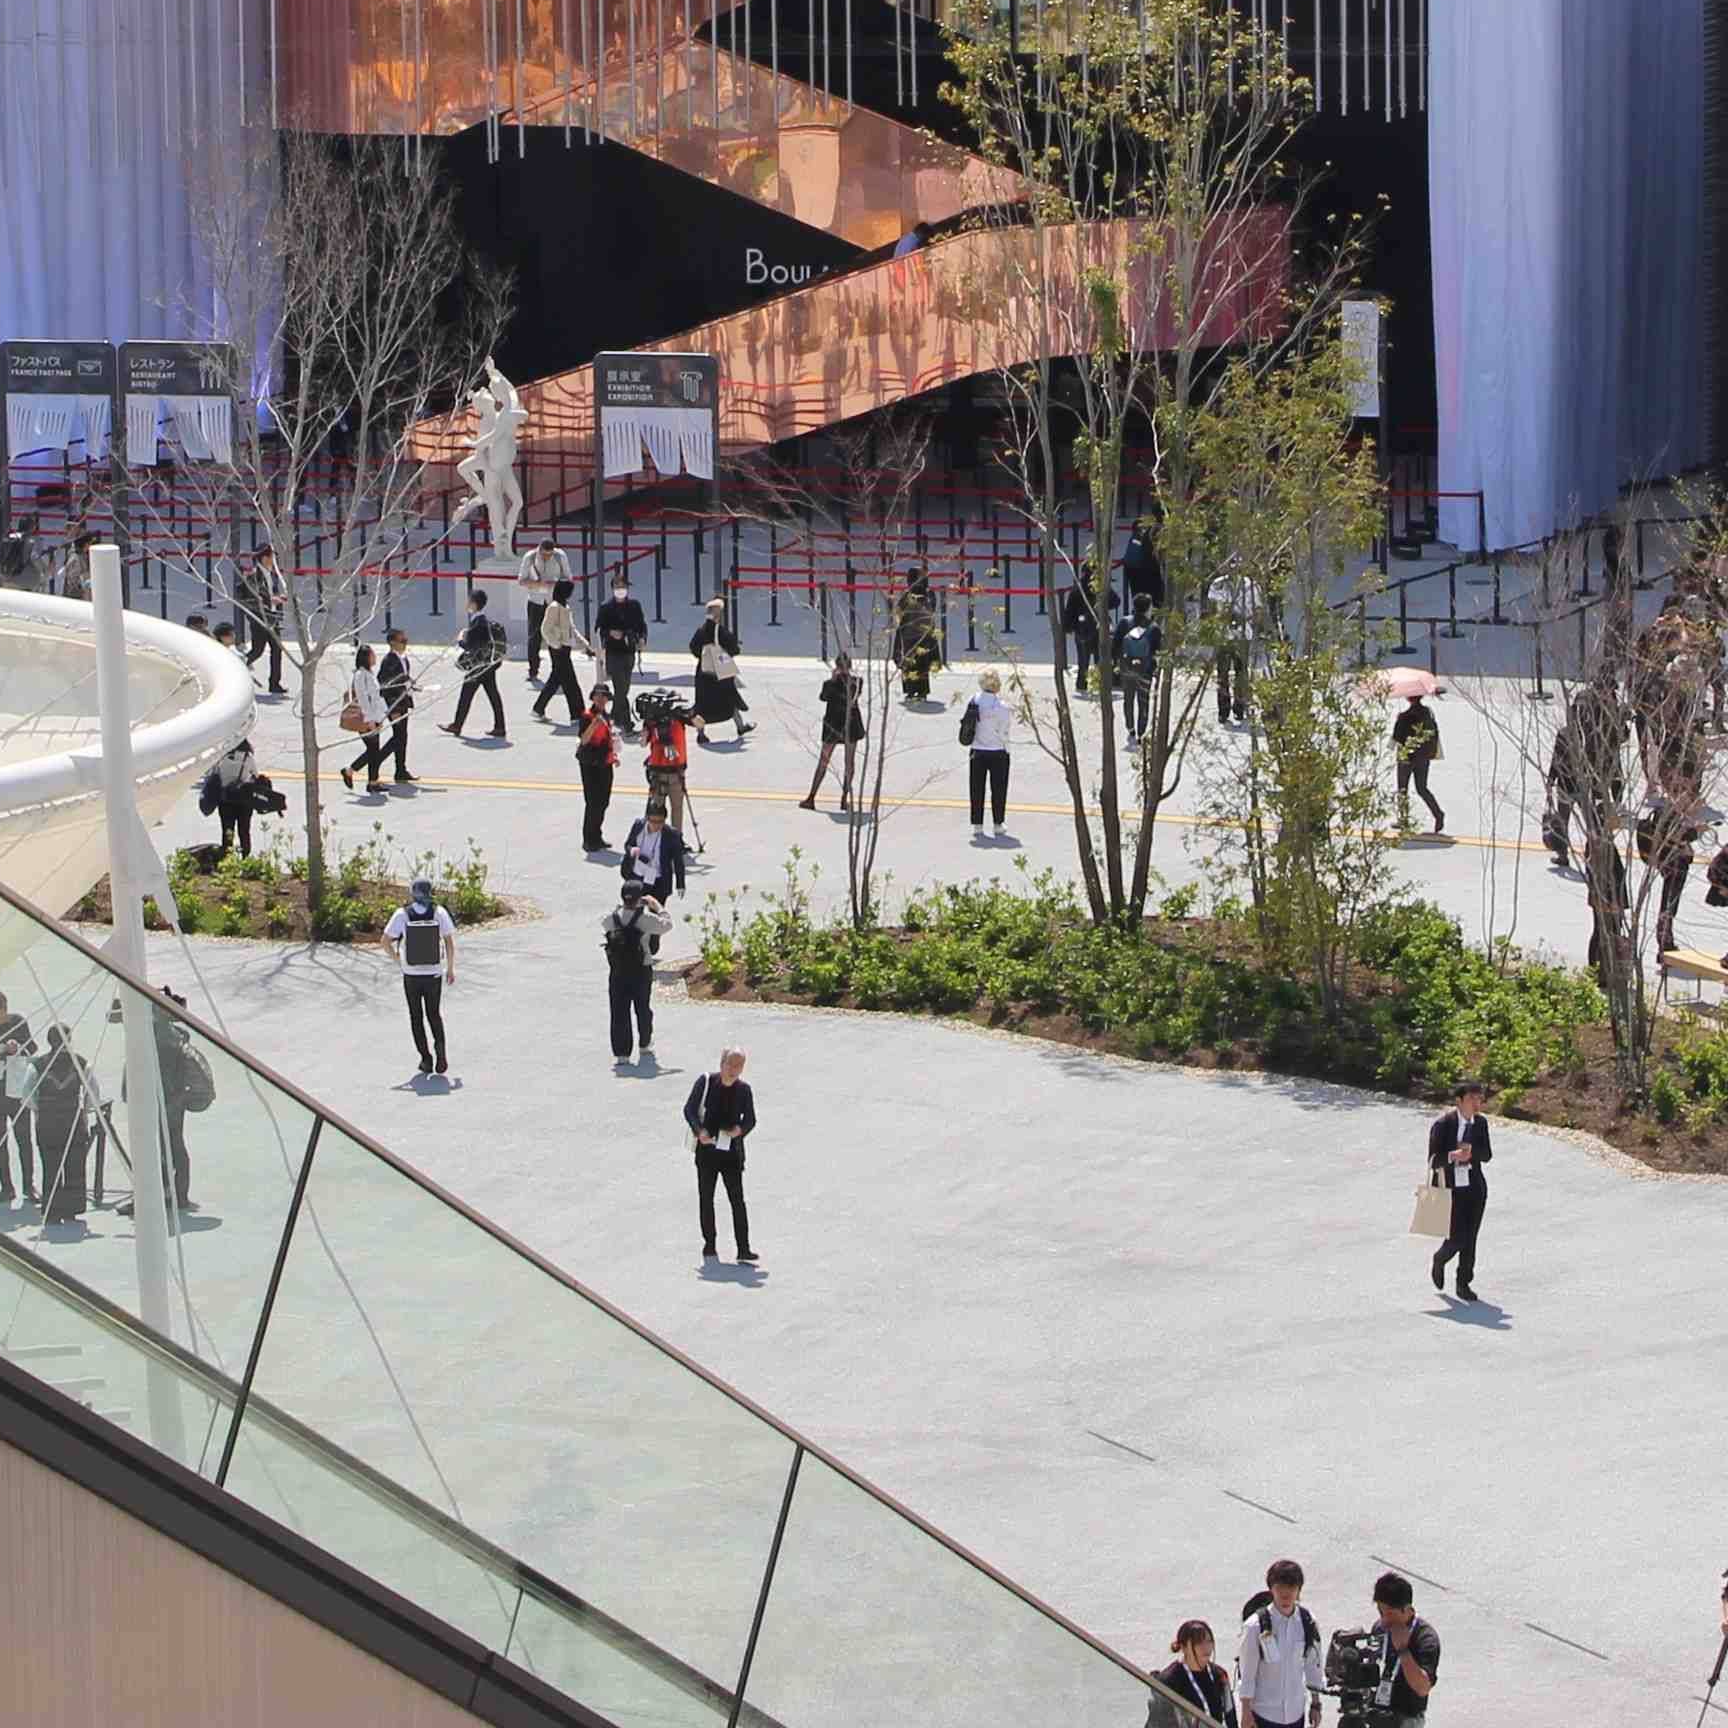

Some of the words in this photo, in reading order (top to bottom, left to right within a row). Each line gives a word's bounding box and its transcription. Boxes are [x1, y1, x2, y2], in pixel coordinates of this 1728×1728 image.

[130, 358, 176, 369] レストラン
[131, 371, 176, 380] RESTAURANT
